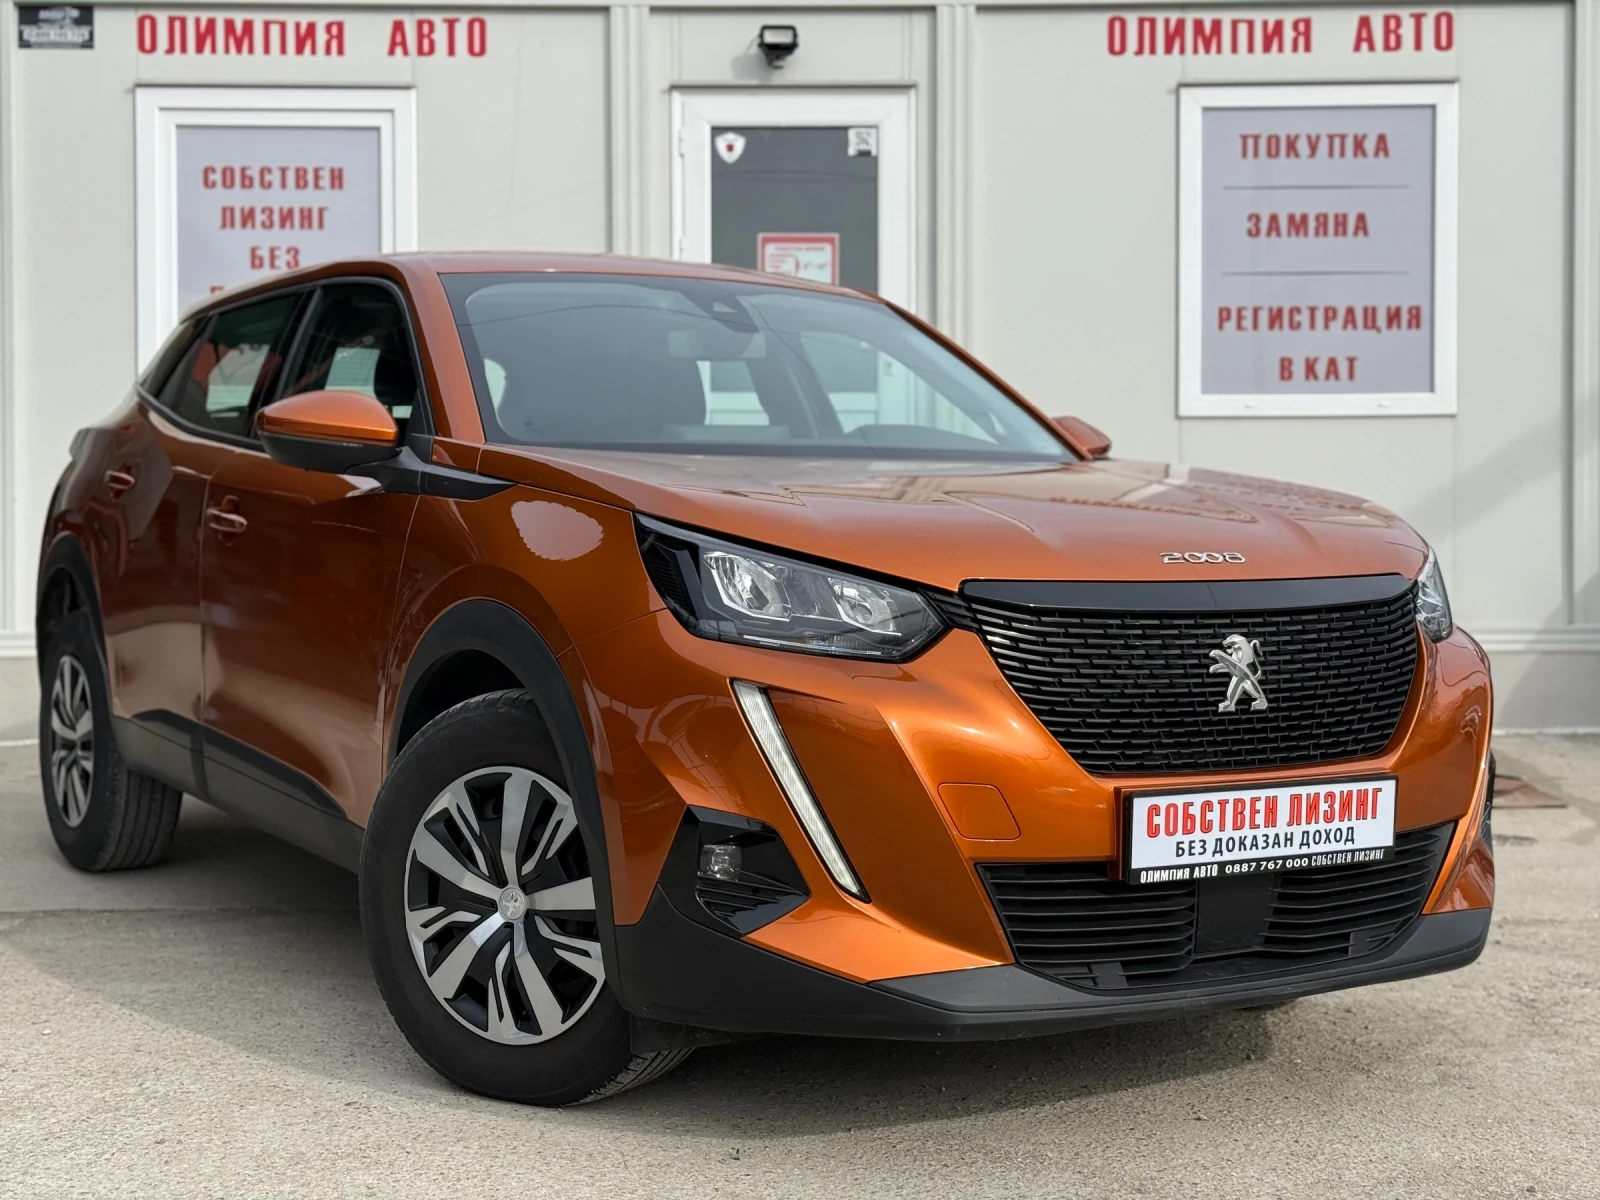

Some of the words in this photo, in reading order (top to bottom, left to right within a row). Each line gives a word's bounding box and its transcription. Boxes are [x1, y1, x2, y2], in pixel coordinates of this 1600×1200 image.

[136, 13, 346, 57] ОЛИМПИЯ
[387, 16, 488, 58] АВТО
[1106, 15, 1313, 57] ОЛИМПИЯ
[1352, 10, 1455, 53] АВТО
[1239, 132, 1390, 159] ПОКУПКА
[202, 165, 345, 191] СОБСТВЕН
[219, 206, 329, 231] ЛИЗИНГ
[1246, 212, 1369, 239] ЗАМЯНА
[249, 246, 301, 270] БЕЗ
[1217, 305, 1422, 334] РЕГИСТРАЦИЯ
[1279, 356, 1294, 382] В
[1304, 356, 1360, 382] КАТ
[1159, 551, 1246, 564] 2008
[1146, 796, 1279, 839] СОБСТВЕН
[1286, 787, 1383, 827] ЛИЗИНГ
[1175, 839, 1207, 858] БЕЗ
[1212, 831, 1294, 858] ДОКАЗАН
[1298, 826, 1356, 850] ДОХОД
[1140, 867, 1190, 884] ОЛИМПИЯ
[1193, 864, 1218, 879] АВТО
[1225, 862, 1257, 875] 0887
[1259, 859, 1283, 871] 767
[1285, 857, 1309, 868] 000
[1311, 852, 1352, 867] СОБСТВЕН
[1353, 848, 1386, 862] ЛИЗИНГ
